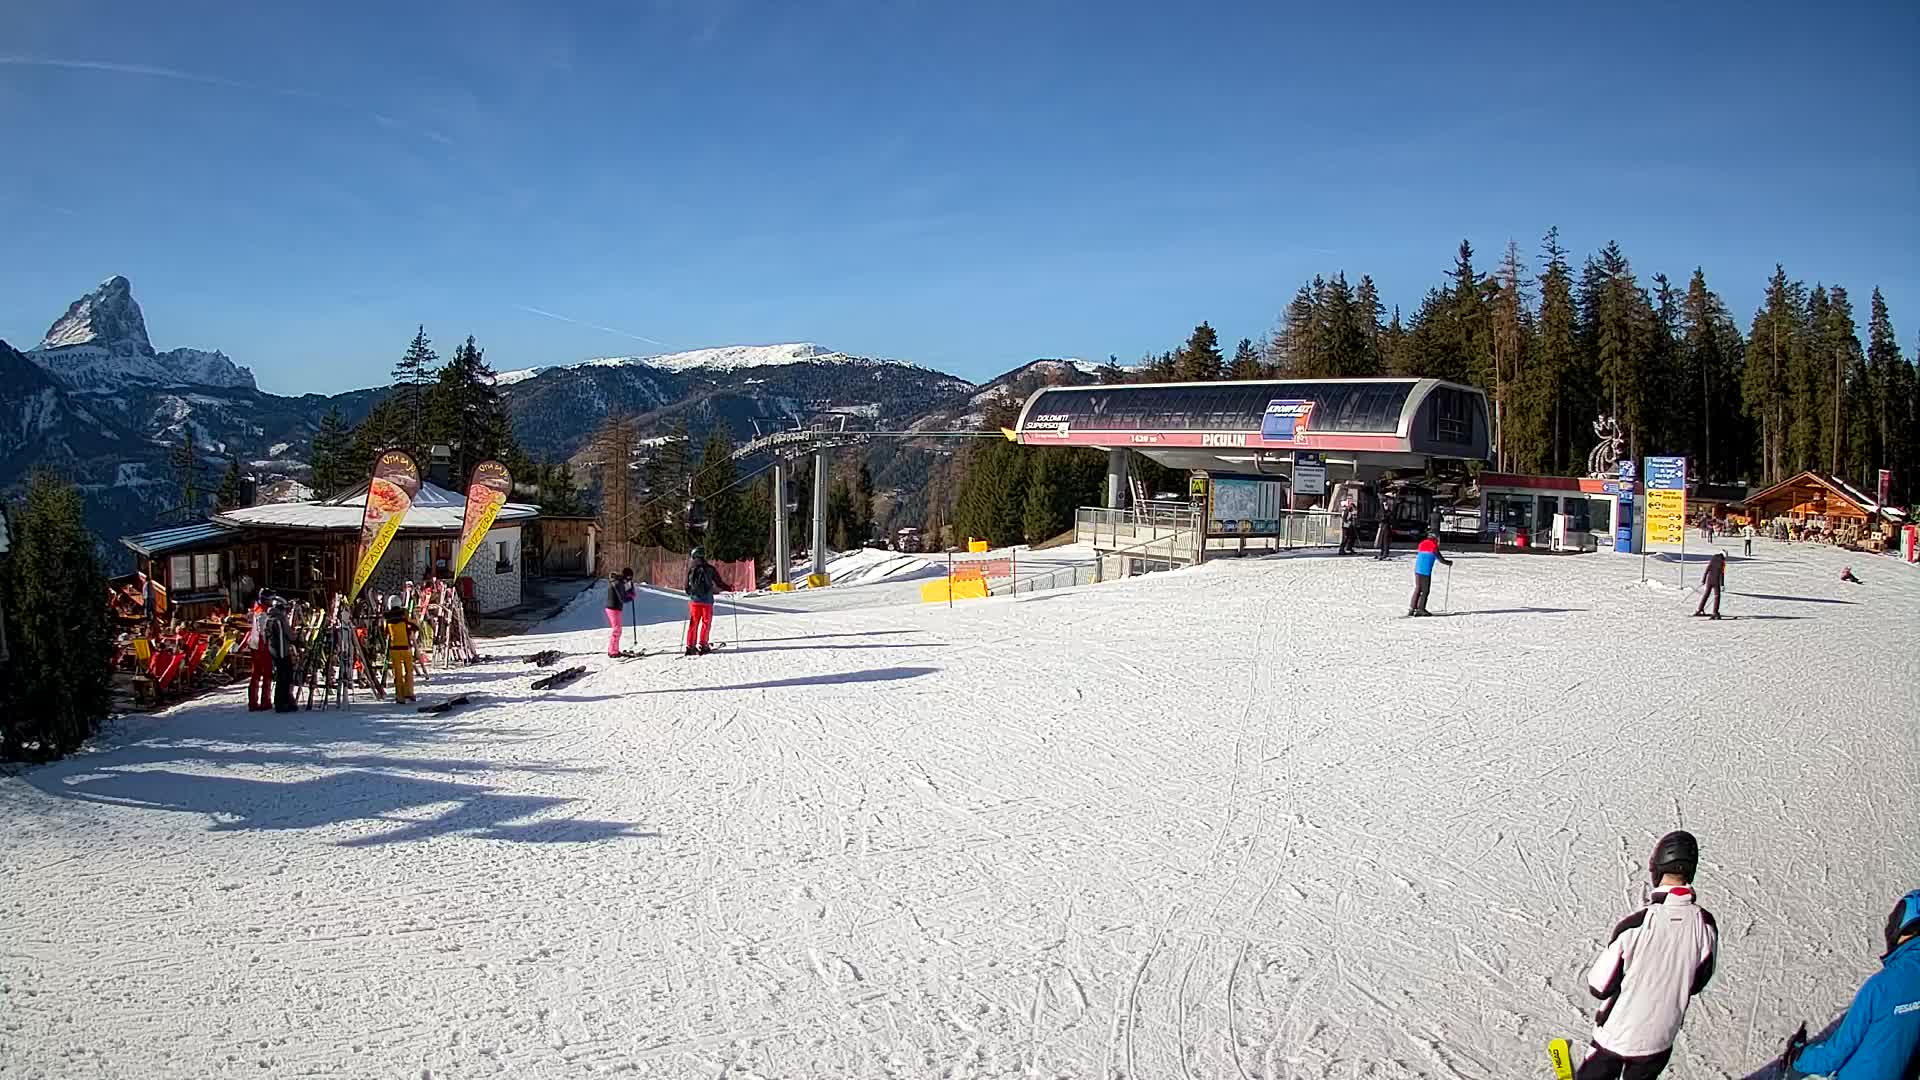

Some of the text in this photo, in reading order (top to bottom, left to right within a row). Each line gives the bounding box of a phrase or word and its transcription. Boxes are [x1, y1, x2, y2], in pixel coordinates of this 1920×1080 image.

[1036, 414, 1069, 422] DOLOMITI
[1202, 433, 1246, 447] PICULIN
[466, 507, 497, 551] PIZZERIA
[354, 517, 398, 586] RESTAURANT
